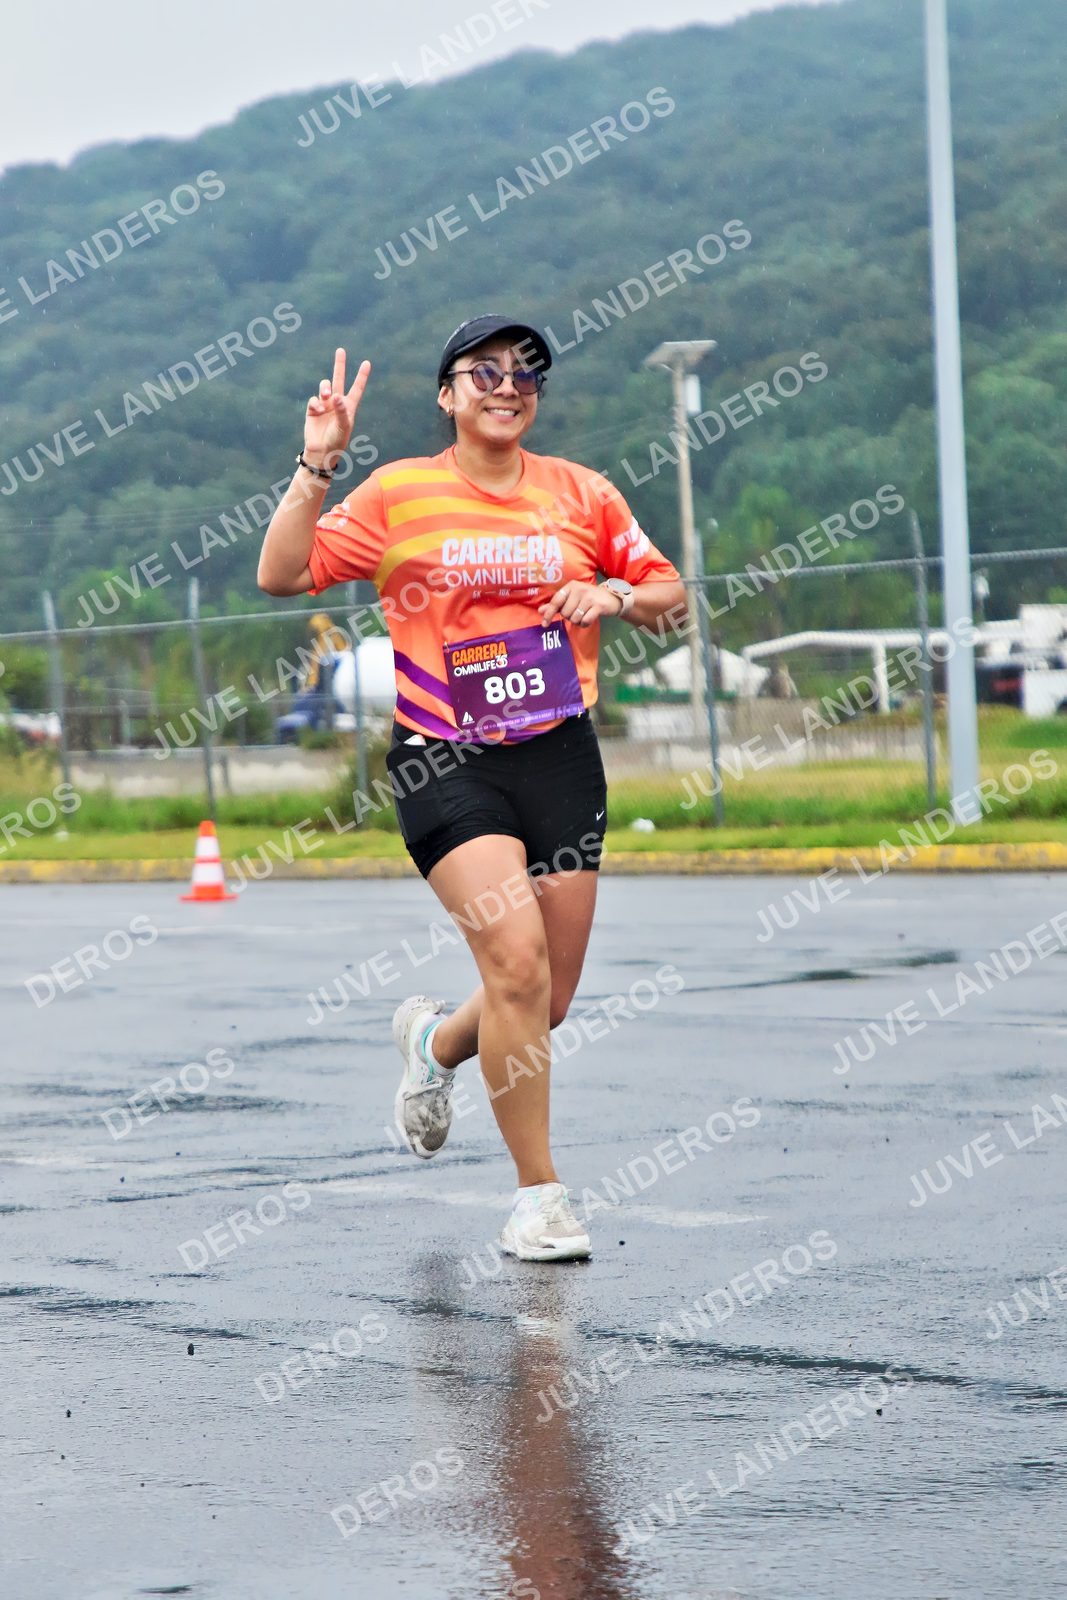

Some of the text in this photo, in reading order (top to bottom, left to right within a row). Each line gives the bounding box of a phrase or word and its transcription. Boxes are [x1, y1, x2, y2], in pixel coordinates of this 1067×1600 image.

[442, 536, 563, 566] CARRERA
[445, 566, 538, 588] OMNILIFE
[541, 629, 562, 651] 15K
[452, 641, 507, 667] CARRERA
[453, 659, 497, 677] OMNILIFE
[484, 668, 546, 704] 803
